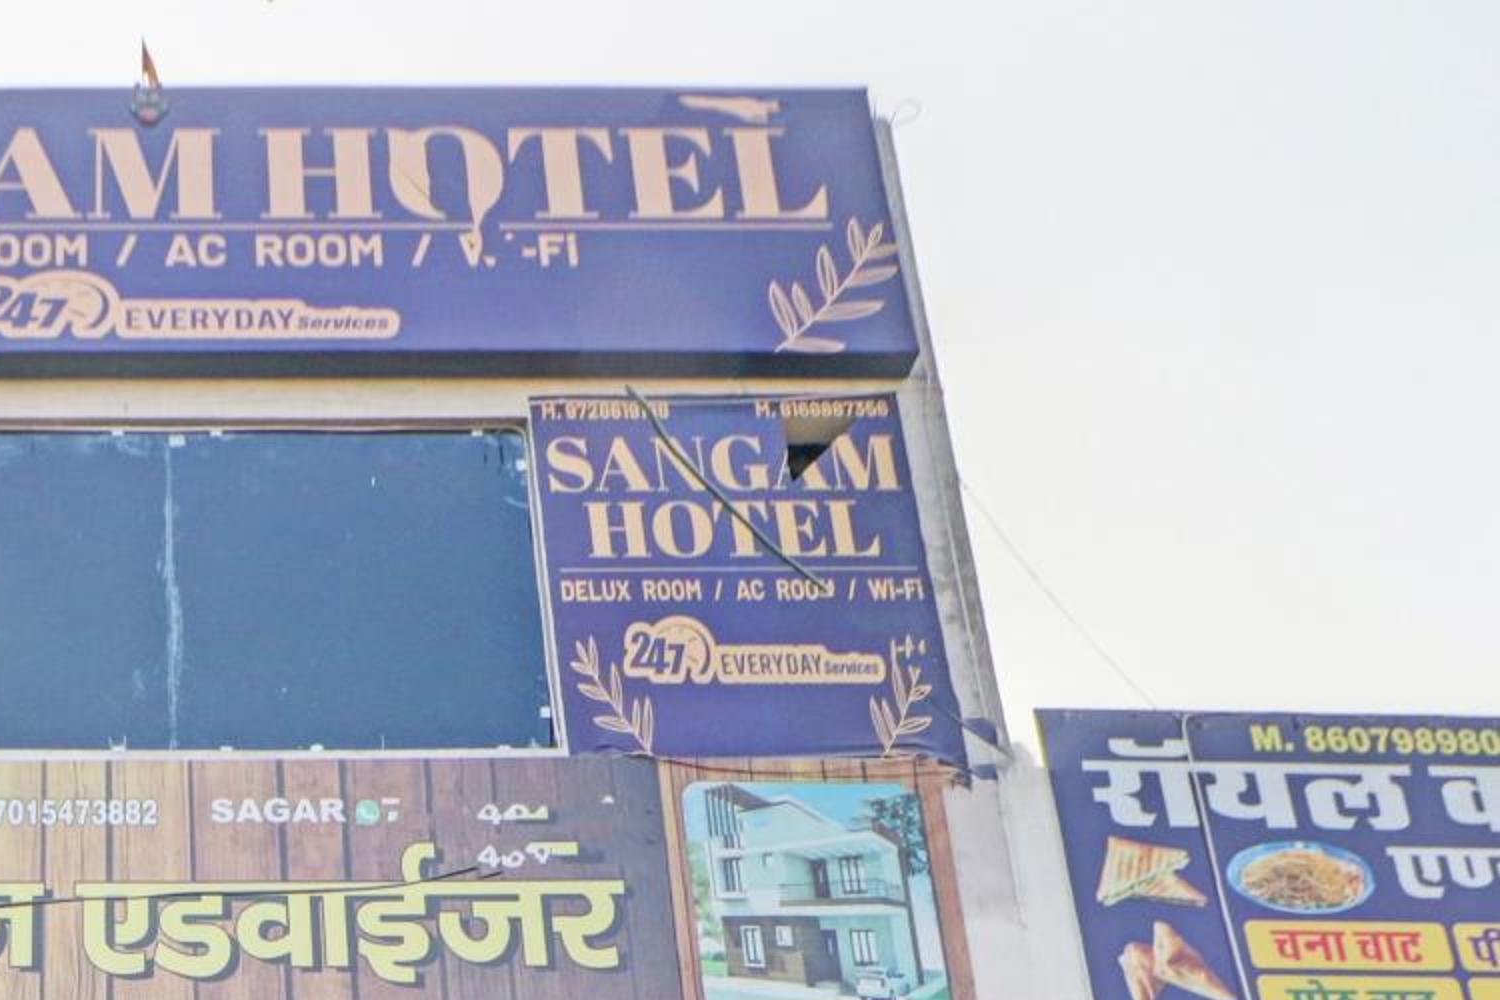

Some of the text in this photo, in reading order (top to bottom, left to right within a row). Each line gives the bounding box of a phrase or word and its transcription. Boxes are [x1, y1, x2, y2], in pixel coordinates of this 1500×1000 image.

[257, 126, 831, 221] HOTEL
[165, 234, 227, 268] AC
[255, 234, 384, 268] ROOM
[125, 305, 294, 331] EVERYDAY
[545, 434, 900, 493] SANGAM
[583, 498, 882, 559] HOTEL
[560, 579, 631, 602] DELUX
[642, 578, 701, 602] ROOM
[737, 578, 765, 601] AC
[719, 653, 822, 676] EVERYDAY
[1249, 724, 1294, 752] M.
[210, 797, 347, 824] SAGAR
[73, 841, 625, 983] एडवाईजर
[1269, 929, 1424, 963] चना चाट
